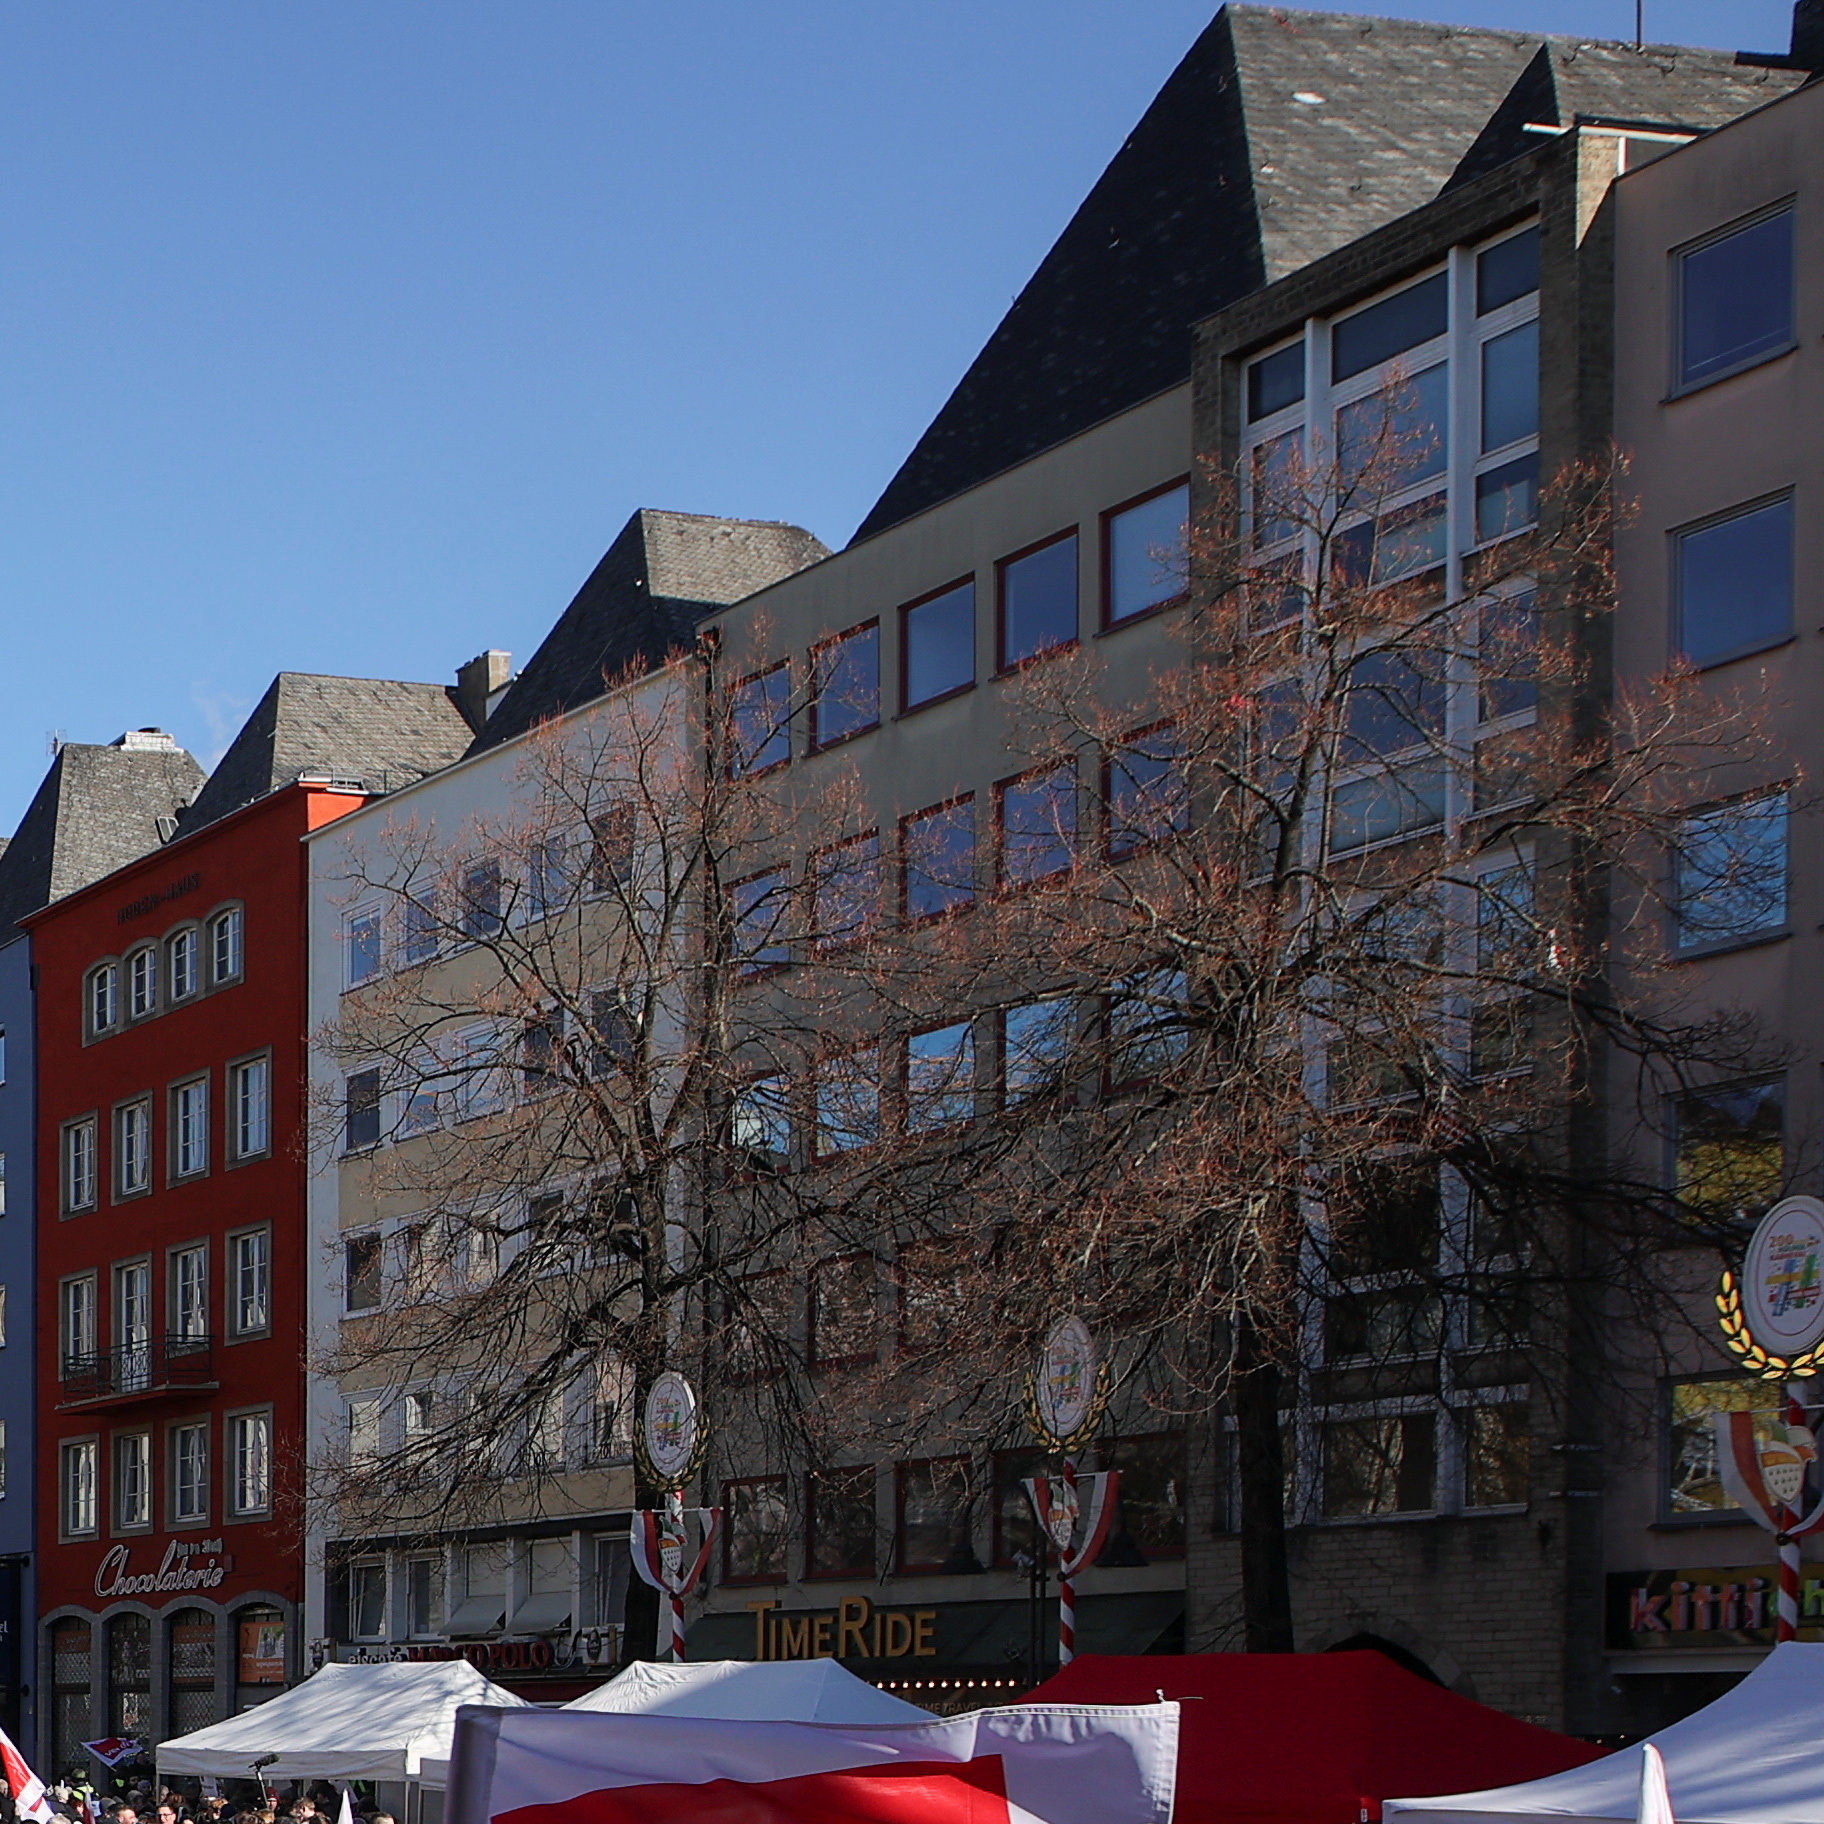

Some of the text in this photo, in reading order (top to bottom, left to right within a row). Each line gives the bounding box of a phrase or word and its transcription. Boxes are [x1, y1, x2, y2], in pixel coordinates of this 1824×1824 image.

[95, 1540, 224, 1598] Chocolaterie
[408, 1643, 484, 1668] MARCO
[487, 1641, 552, 1668] POLO
